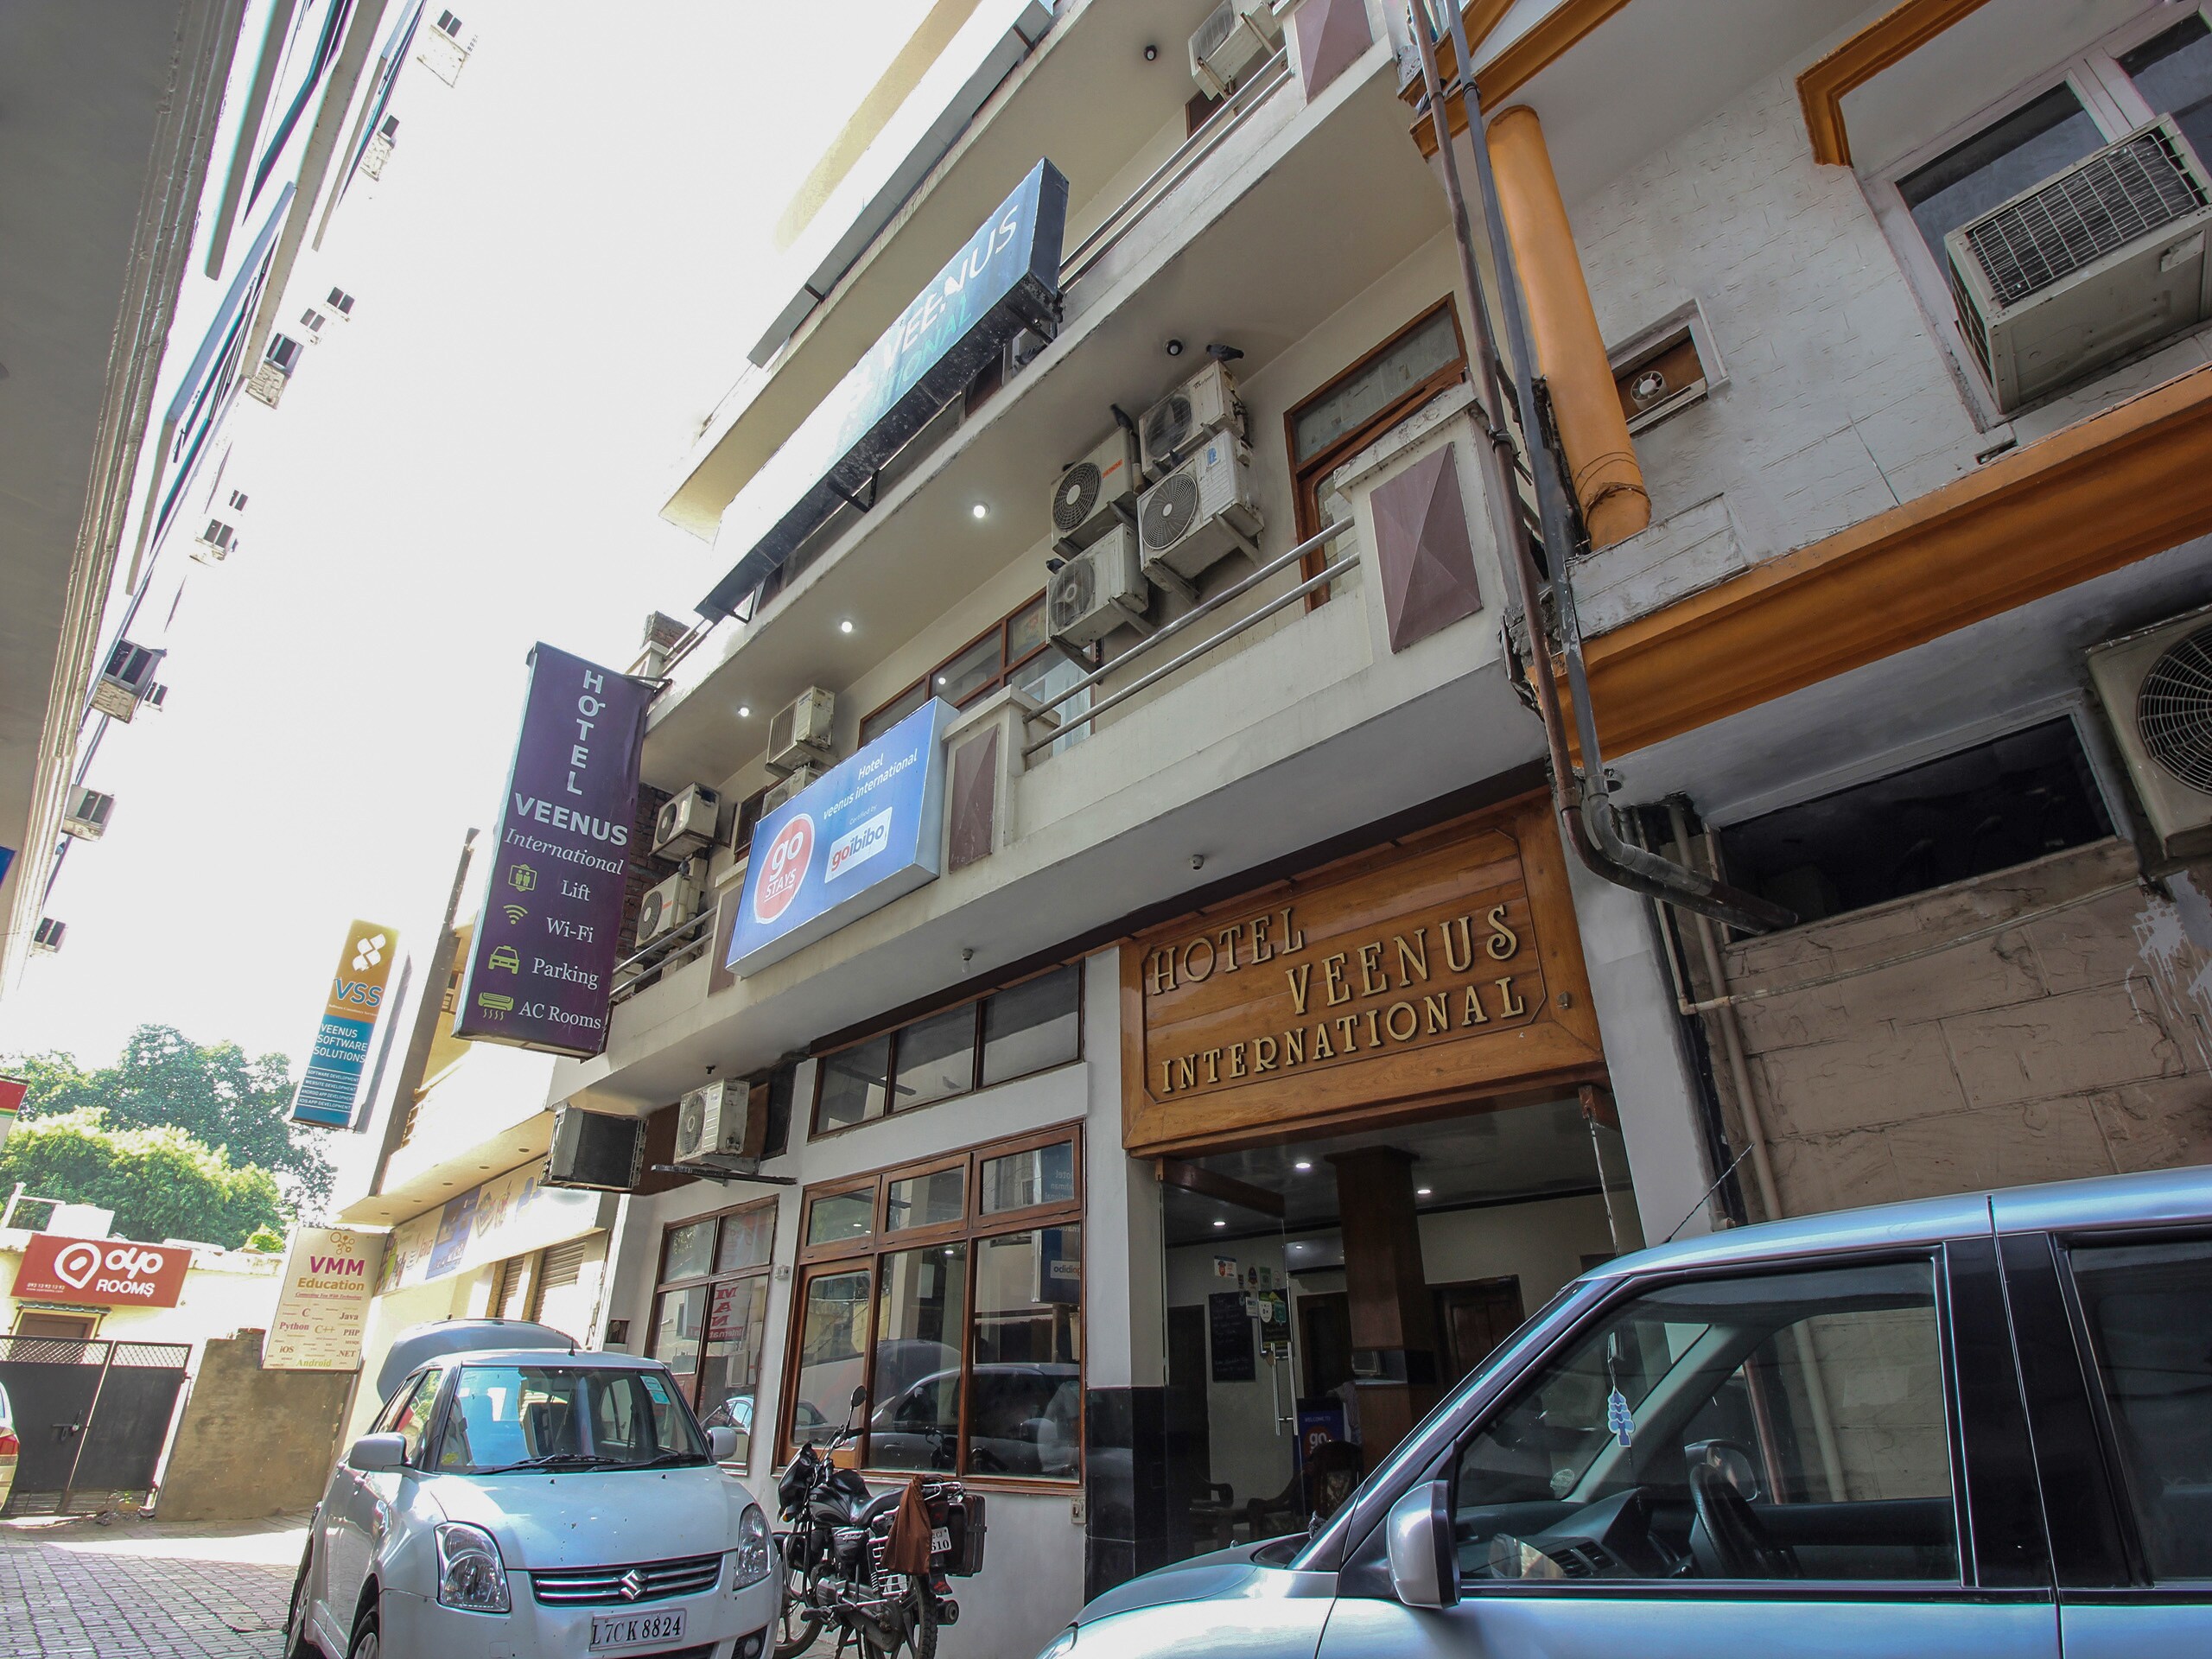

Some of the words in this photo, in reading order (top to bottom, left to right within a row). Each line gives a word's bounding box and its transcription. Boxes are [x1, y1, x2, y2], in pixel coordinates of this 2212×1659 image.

[567, 669, 606, 796] HOTEL
[857, 753, 884, 781] Hotel
[823, 791, 855, 821] veenus
[855, 747, 918, 801] international
[514, 792, 628, 847] VEENUS
[504, 828, 625, 876] International
[769, 830, 804, 883] go
[830, 824, 886, 873] goibibo
[561, 879, 591, 902] Lift
[765, 868, 798, 899] STAYS
[546, 917, 594, 944] Wi-Fi
[1150, 906, 1304, 996] HOTEL
[1285, 903, 1518, 1015] VEENUS
[531, 957, 599, 990] Parking
[335, 976, 384, 1007] VSS
[518, 1003, 545, 1020] AC
[547, 1007, 602, 1030] Rooms
[321, 1023, 358, 1039] VEENUS
[1160, 976, 1525, 1094] INTERNATIONAL
[316, 1034, 368, 1052] SOFTWARE
[313, 1046, 366, 1064] SOLUTIONS
[324, 1083, 356, 1092] DEVELOPMENT
[329, 1073, 359, 1083] DEVELOPMENT
[318, 1101, 351, 1110] DEVELOPMENT
[309, 1255, 365, 1276] VMM
[95, 1279, 156, 1298] ROOMS
[297, 1277, 365, 1291] Education
[302, 1307, 311, 1318] C
[339, 1312, 359, 1320] Java
[279, 1321, 310, 1332] Python
[315, 1325, 336, 1334] C++
[296, 1358, 333, 1368] Android
[1309, 1432, 1327, 1450] go
[641, 1615, 682, 1639] 8824
